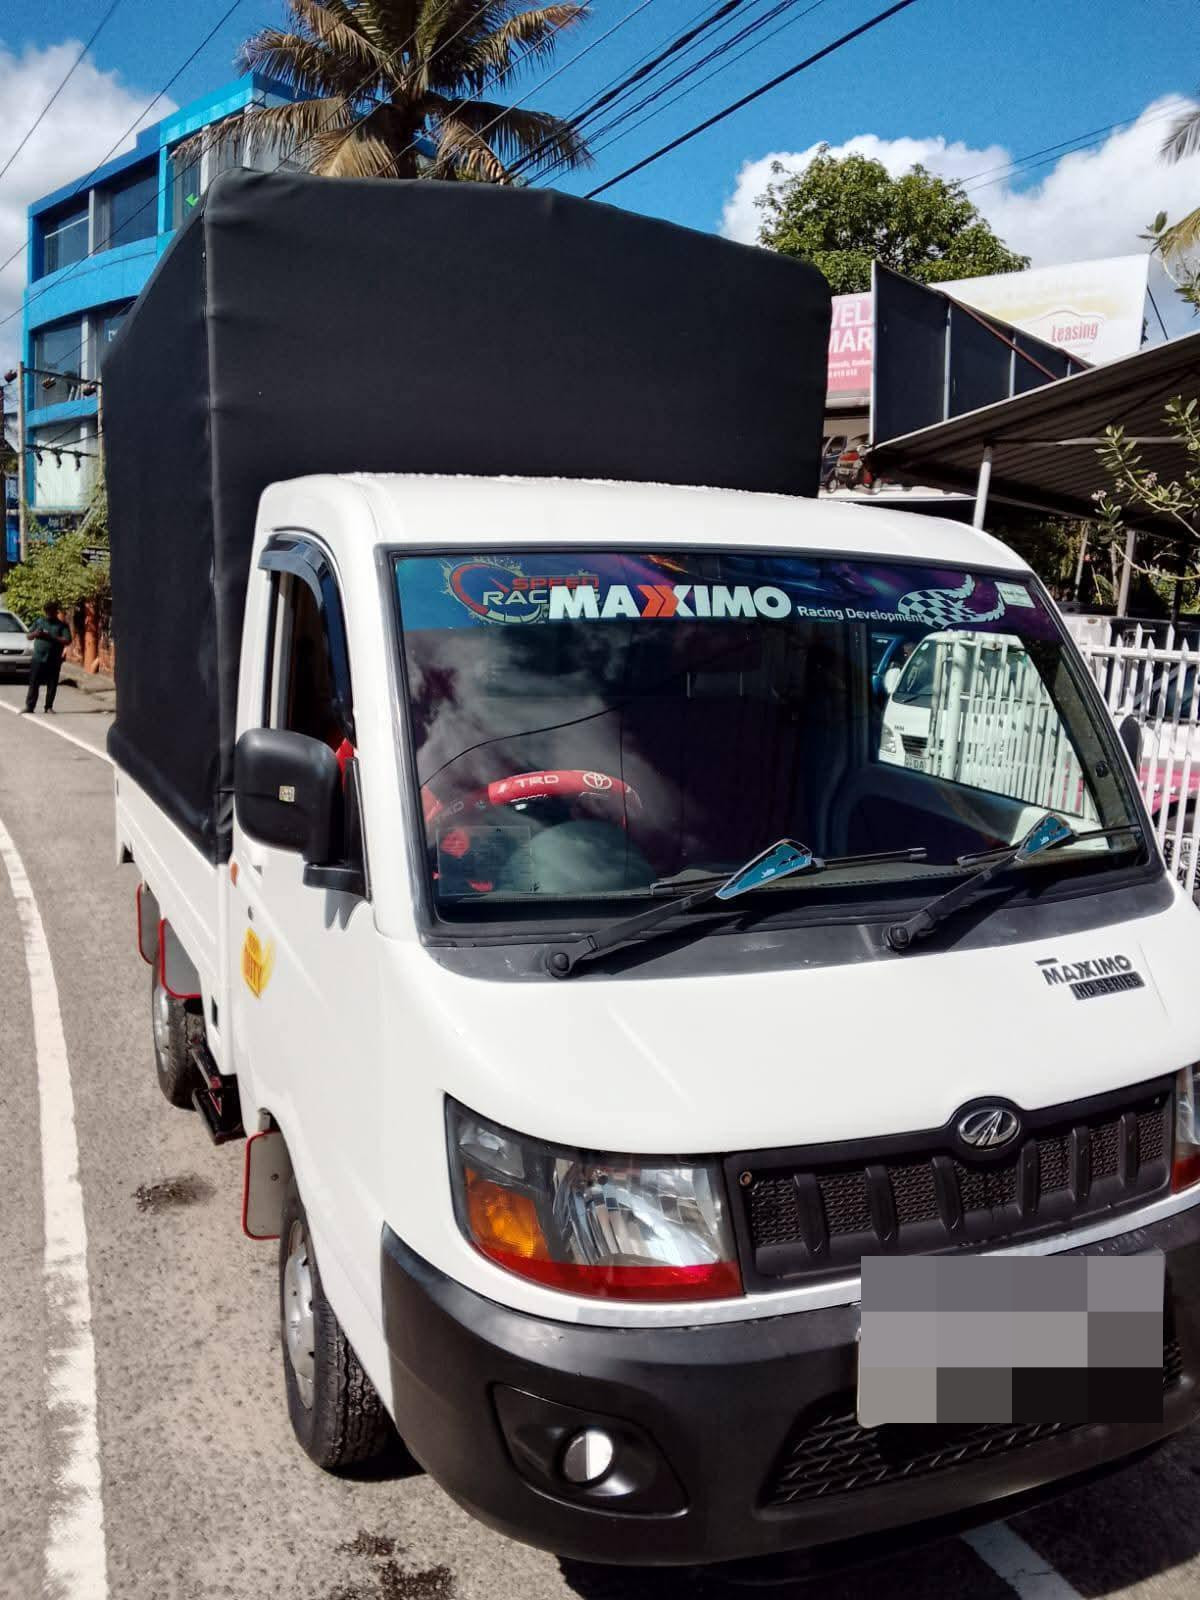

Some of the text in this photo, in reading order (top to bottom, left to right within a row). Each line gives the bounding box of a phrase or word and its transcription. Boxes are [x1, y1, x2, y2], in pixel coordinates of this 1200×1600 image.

[1051, 322, 1098, 344] Leasing
[797, 606, 926, 622] Racing Development
[515, 775, 559, 788] TRD
